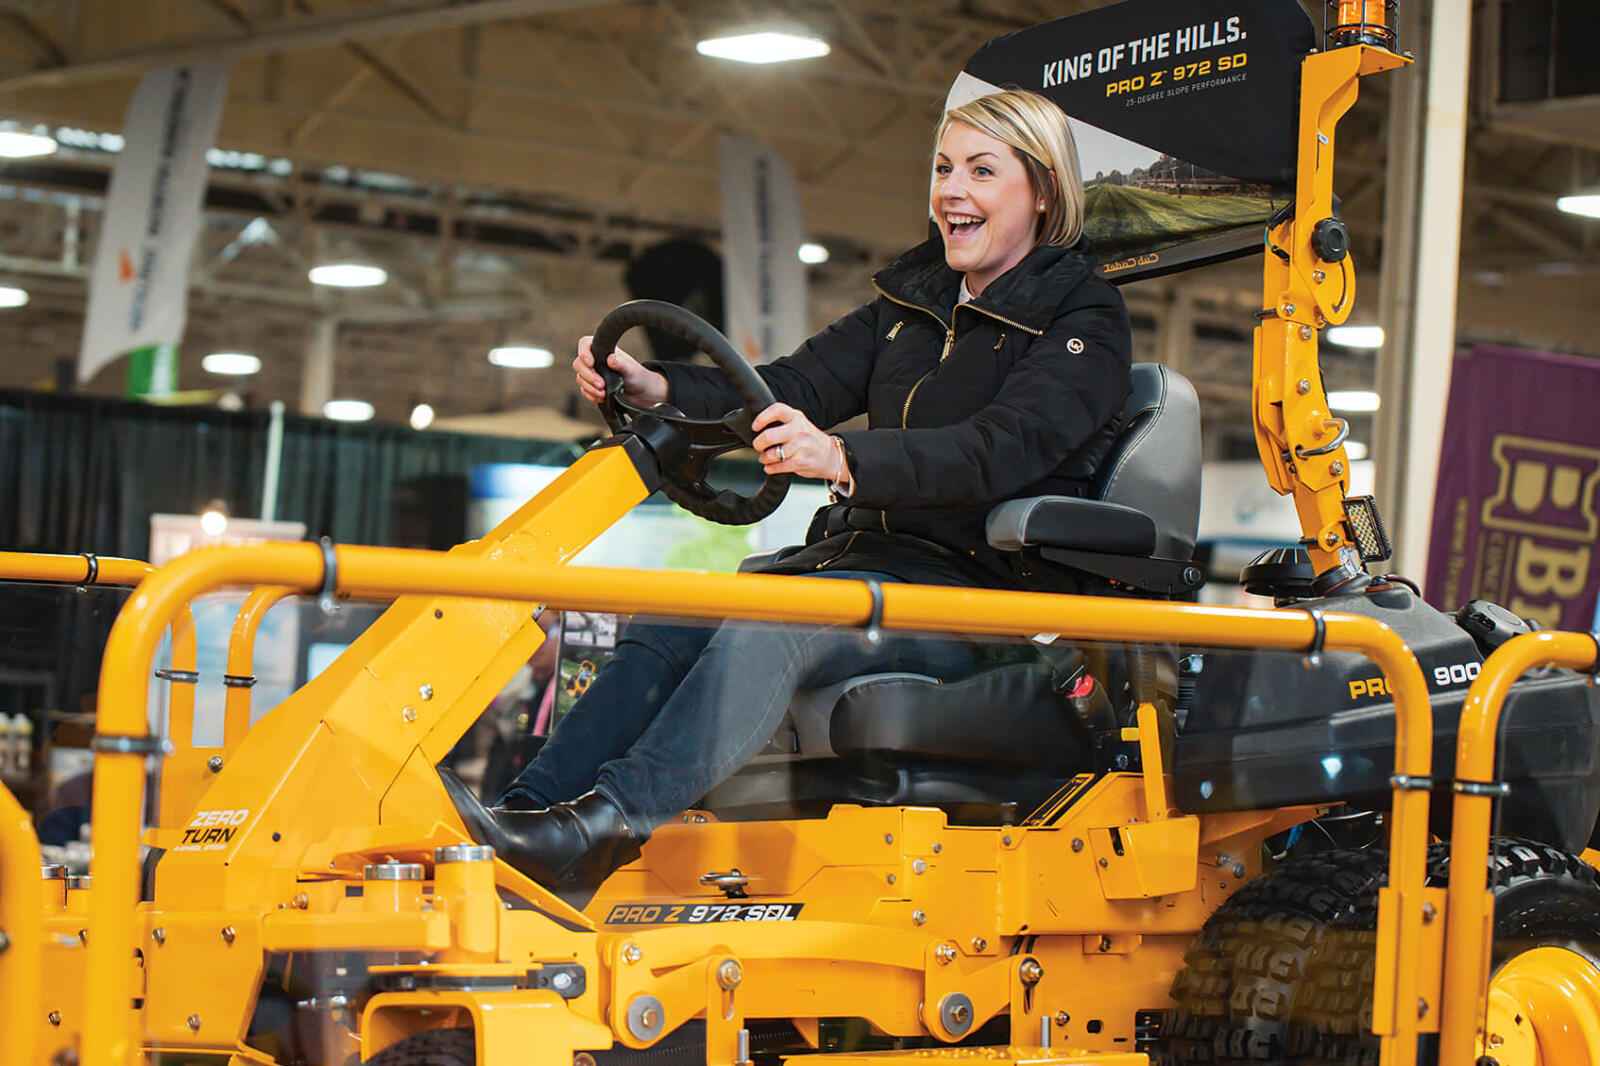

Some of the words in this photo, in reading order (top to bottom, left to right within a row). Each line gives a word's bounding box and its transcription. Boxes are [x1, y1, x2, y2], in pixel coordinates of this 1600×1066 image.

[1042, 52, 1093, 89] KING
[1097, 43, 1125, 74] OF
[1128, 32, 1171, 66] THE
[1175, 16, 1248, 55] HILLS.
[1106, 75, 1145, 98] PRO
[1173, 60, 1211, 81] 972
[1217, 52, 1248, 71] SD
[1125, 91, 1165, 107] 25-DEGREE
[1166, 85, 1190, 97] SLOPE
[1191, 72, 1248, 92] PERFORMANCE
[1433, 661, 1482, 686] 900
[189, 809, 250, 828] ZERO
[181, 827, 238, 844] TURN
[607, 905, 661, 923] PRO
[663, 905, 686, 922] Z
[744, 904, 797, 922] SDL
